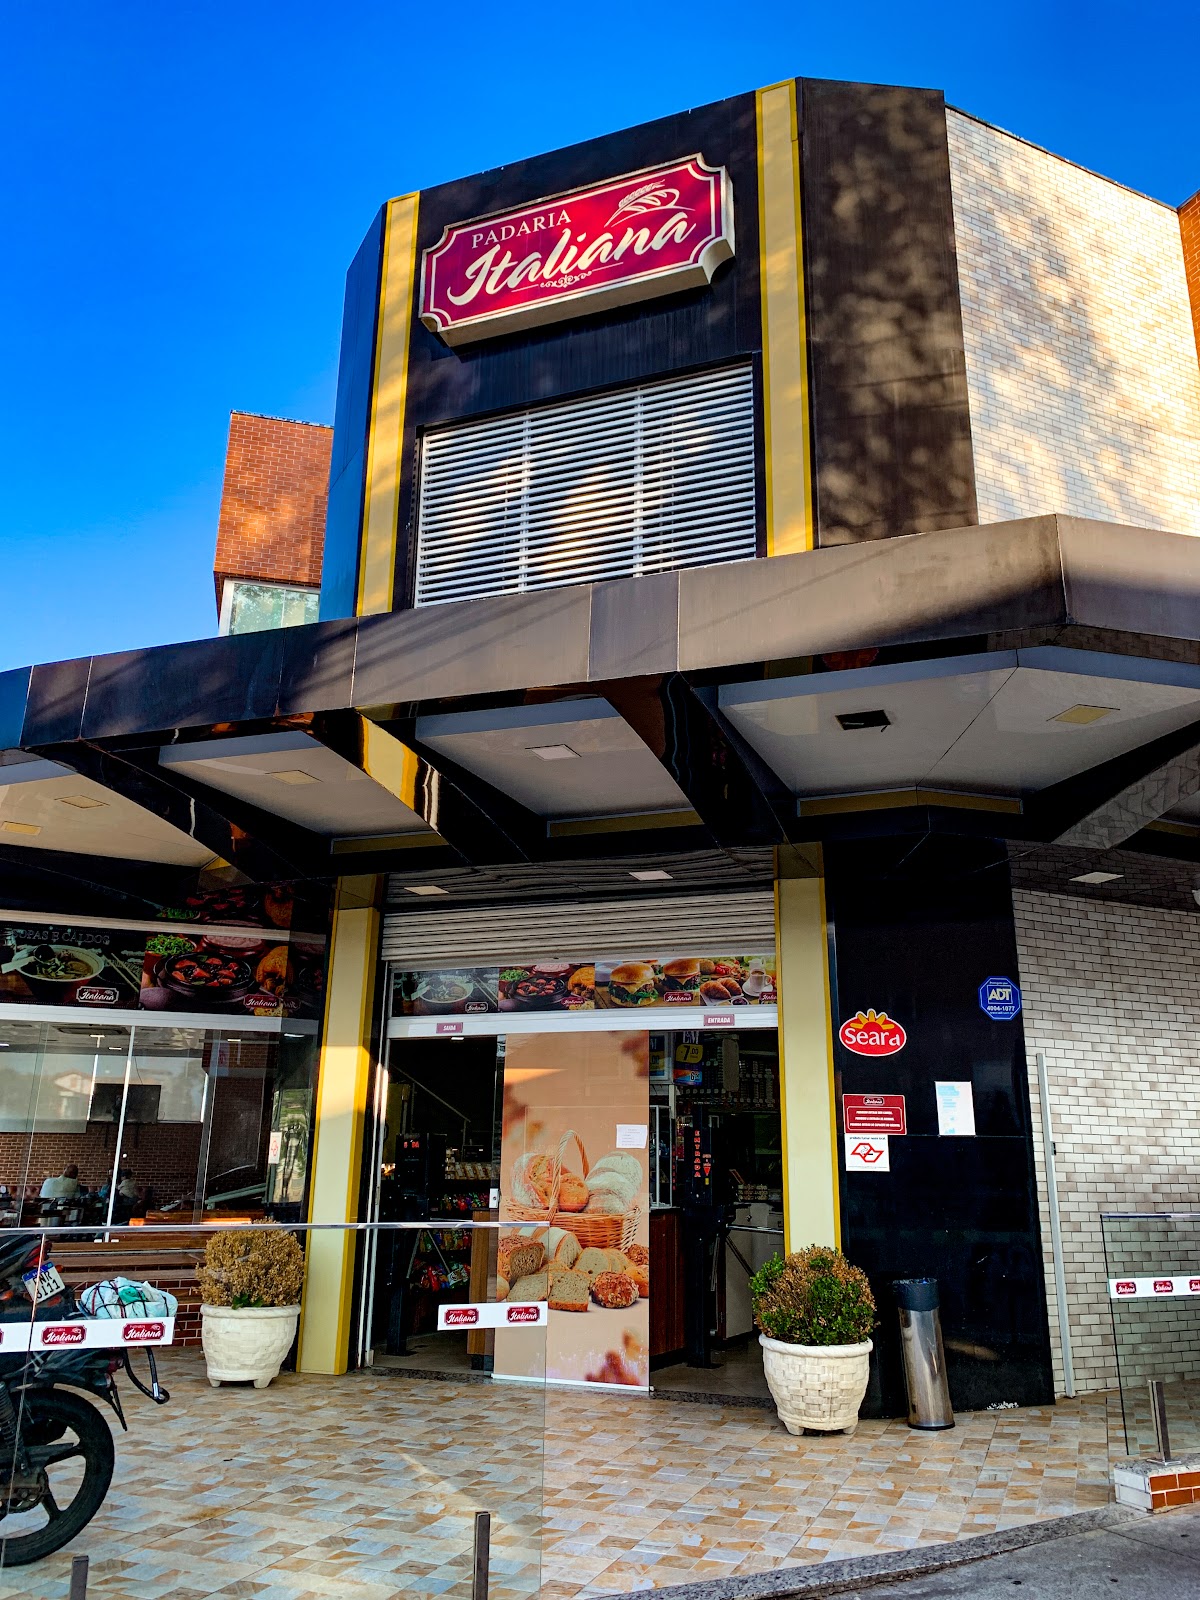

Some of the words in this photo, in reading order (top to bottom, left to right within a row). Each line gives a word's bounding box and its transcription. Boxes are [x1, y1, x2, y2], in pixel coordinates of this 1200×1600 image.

[472, 209, 572, 249] PADARIA
[447, 212, 697, 307] Italiana
[989, 988, 1011, 1001] ADT
[845, 1028, 900, 1046] Seara
[447, 1313, 476, 1324] Italiana
[508, 1311, 537, 1321] Italiana
[43, 1332, 82, 1343] Italiana
[124, 1328, 161, 1339] Italiana
